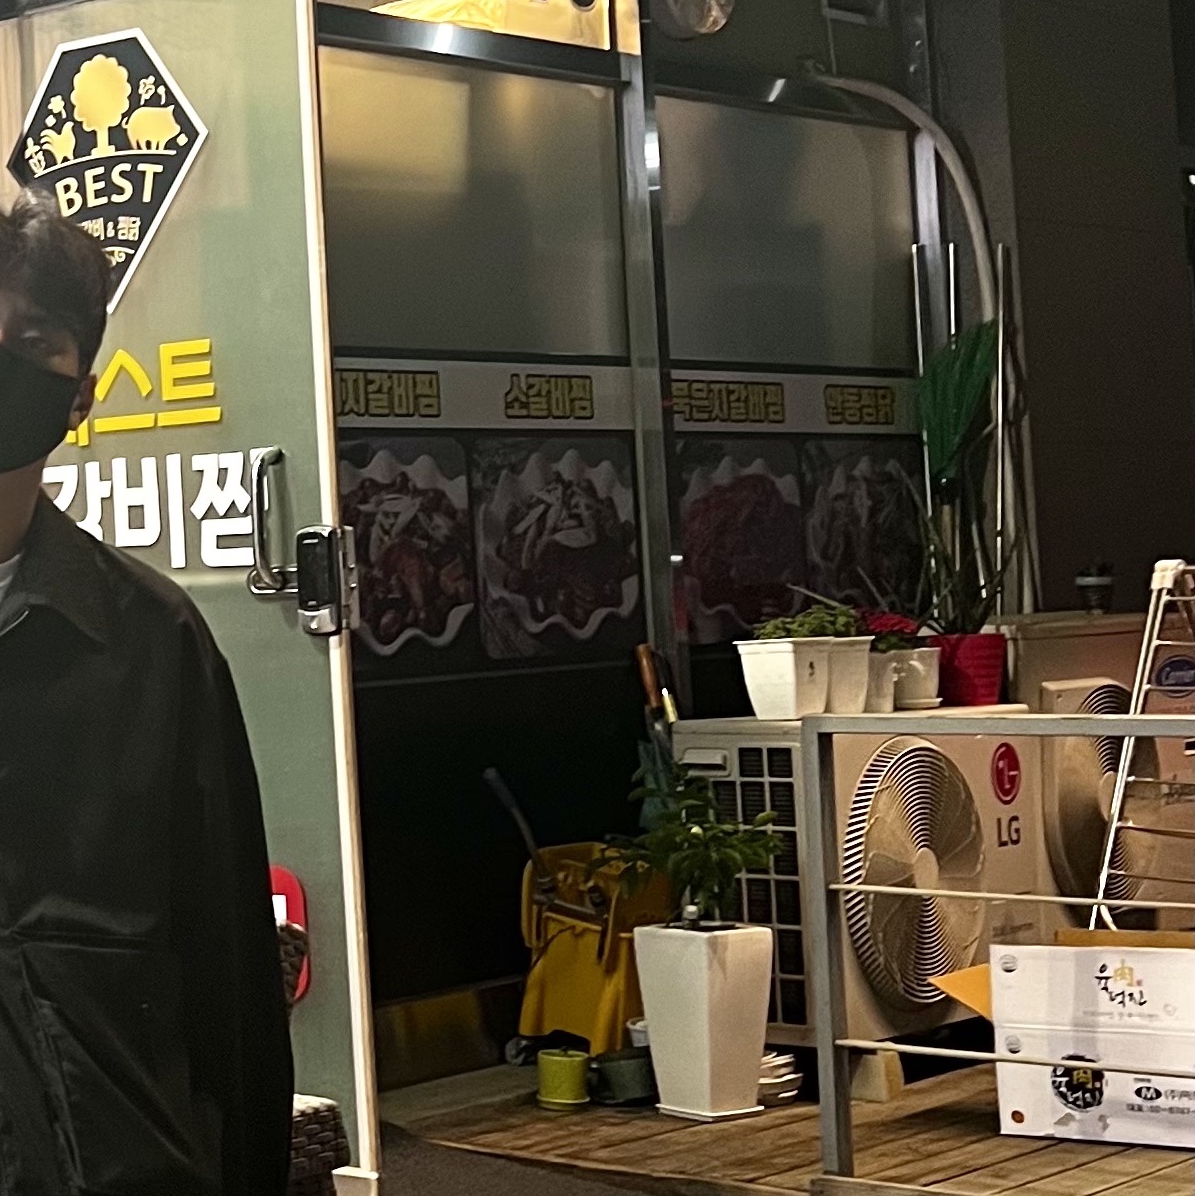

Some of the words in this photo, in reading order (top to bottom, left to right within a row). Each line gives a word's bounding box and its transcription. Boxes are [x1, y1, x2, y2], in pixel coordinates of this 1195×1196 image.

[54, 162, 164, 218] BEST
[106, 221, 115, 238] &
[65, 338, 222, 447] 스트
[335, 370, 442, 418] 지갈비찜
[504, 373, 595, 420] 소갈비찜
[996, 815, 1022, 848] LG
